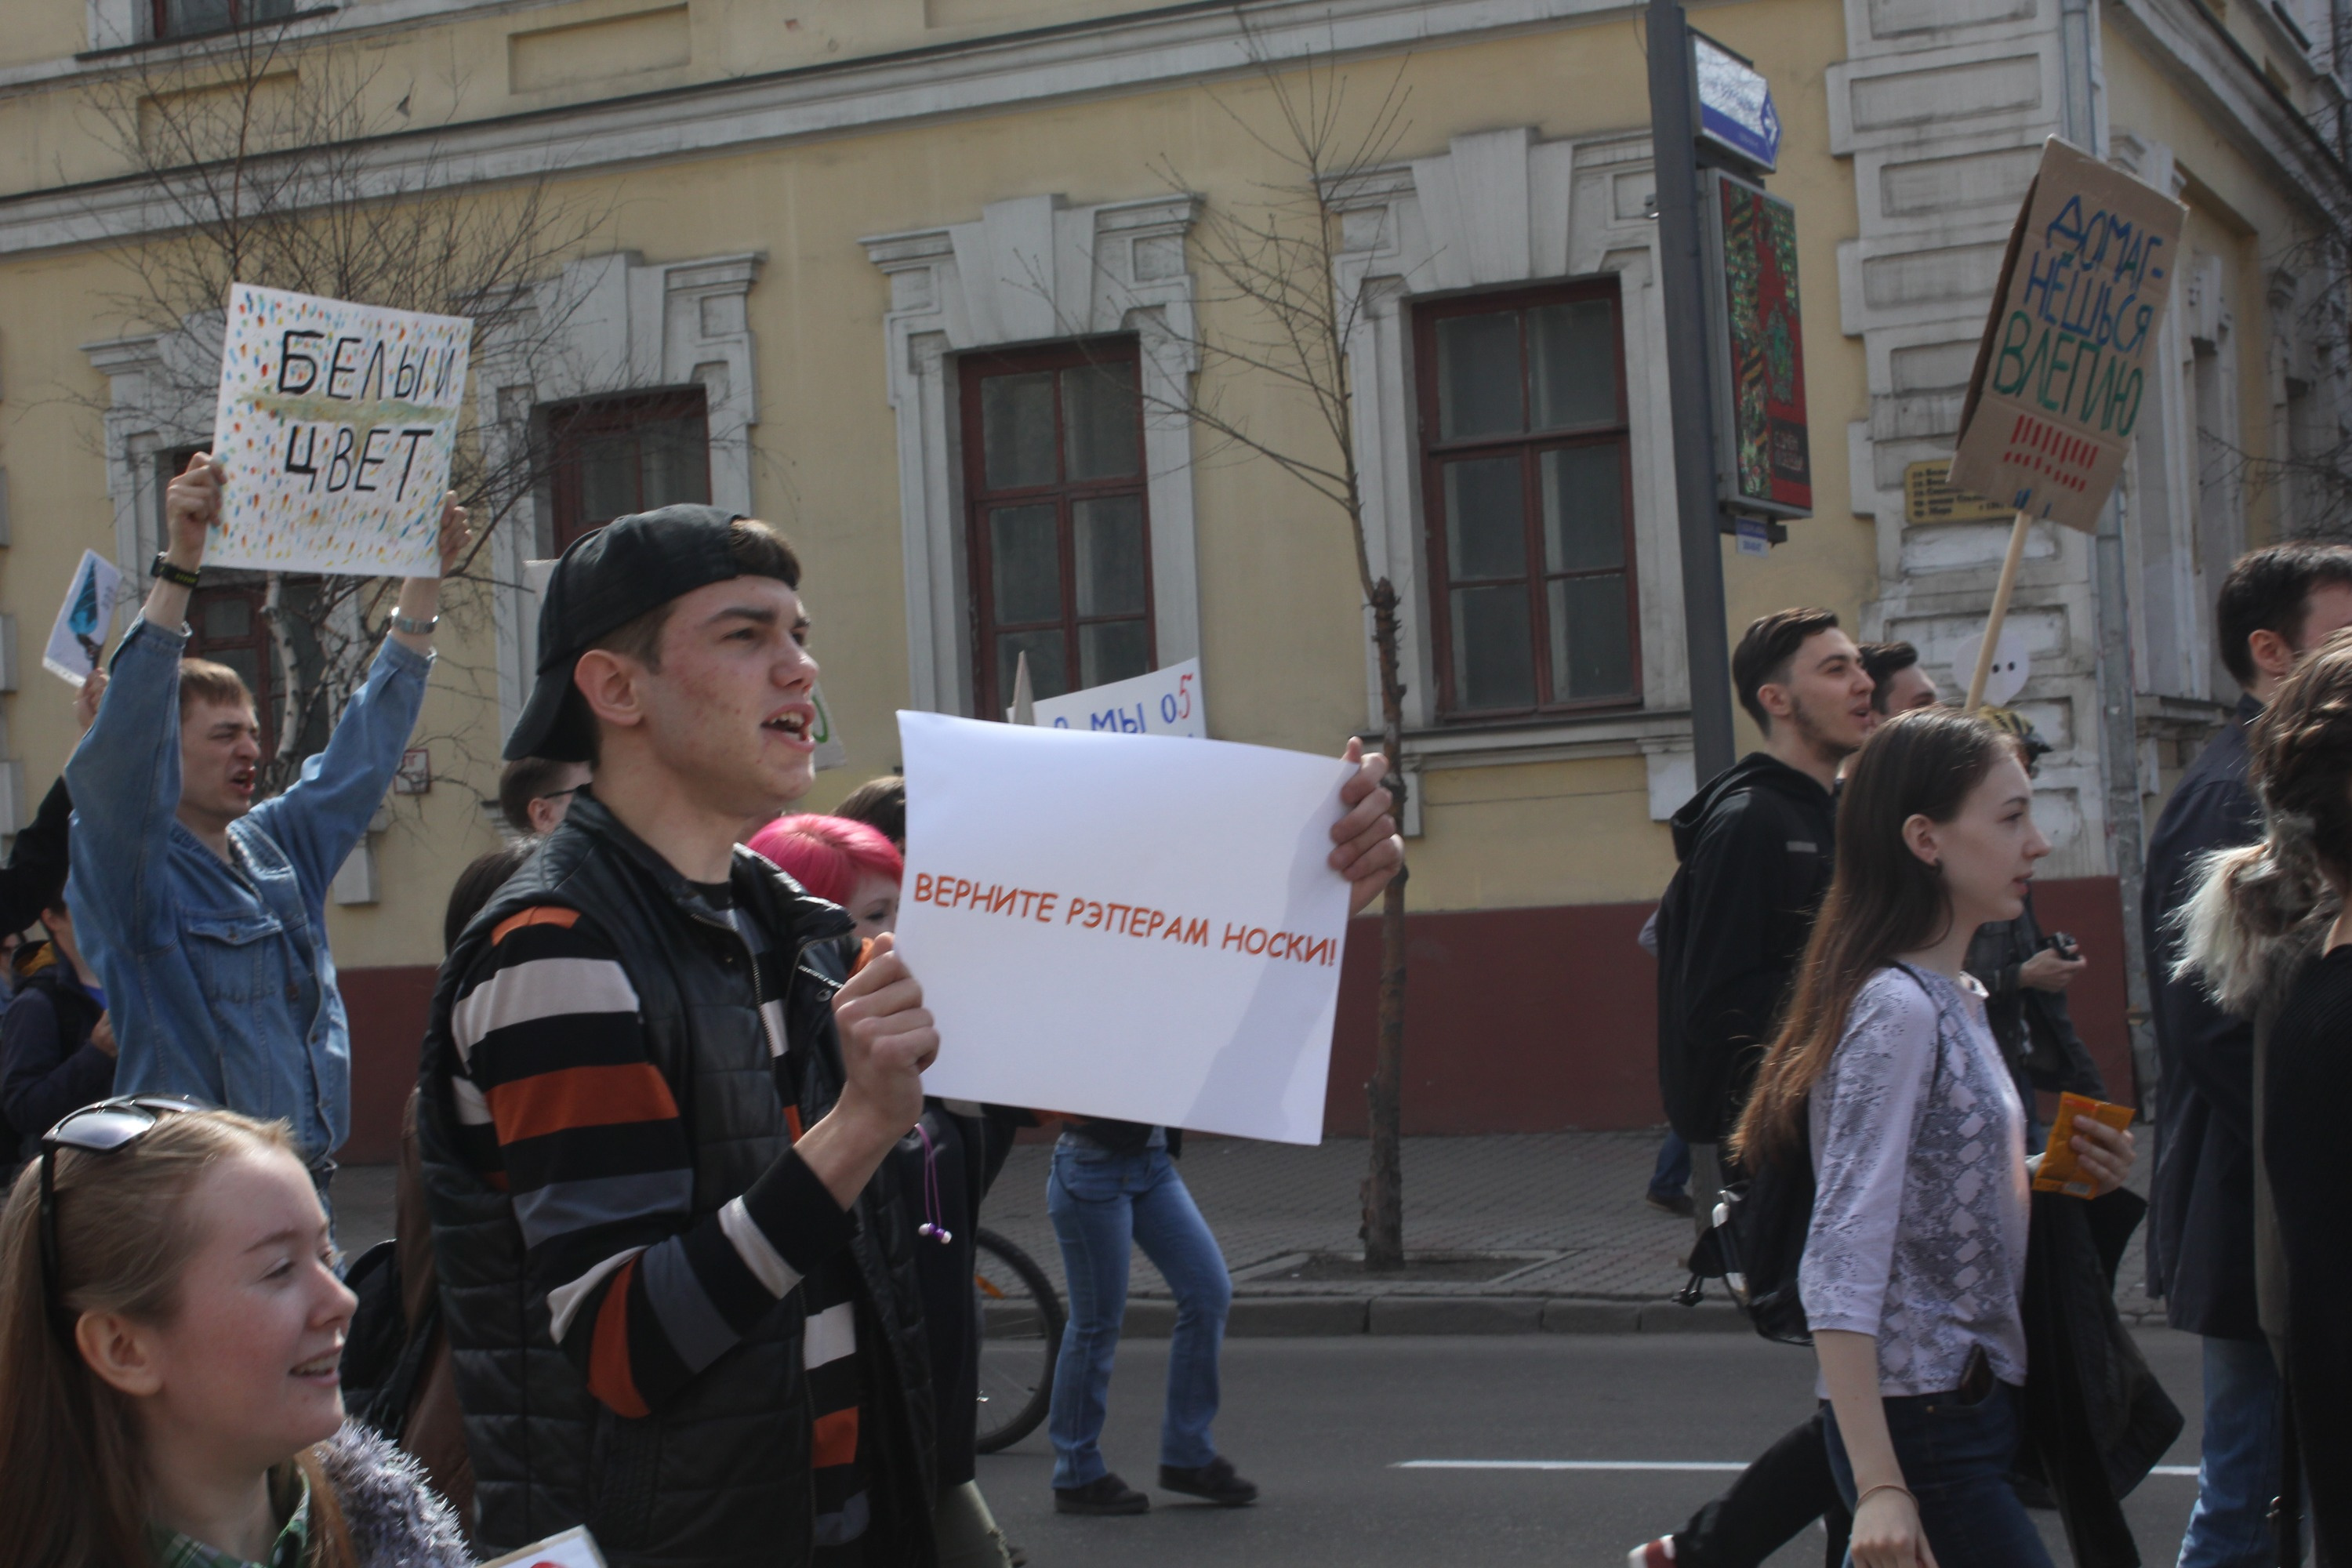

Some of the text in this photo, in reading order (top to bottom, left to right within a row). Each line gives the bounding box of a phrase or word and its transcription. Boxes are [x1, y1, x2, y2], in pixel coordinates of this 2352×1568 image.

[278, 329, 456, 401] БЕЛЫЙ
[283, 425, 434, 503] ЦВЕТ
[913, 872, 1338, 967] ВЕРНИТЕ РЭПЕРАМ НОСКИ!
